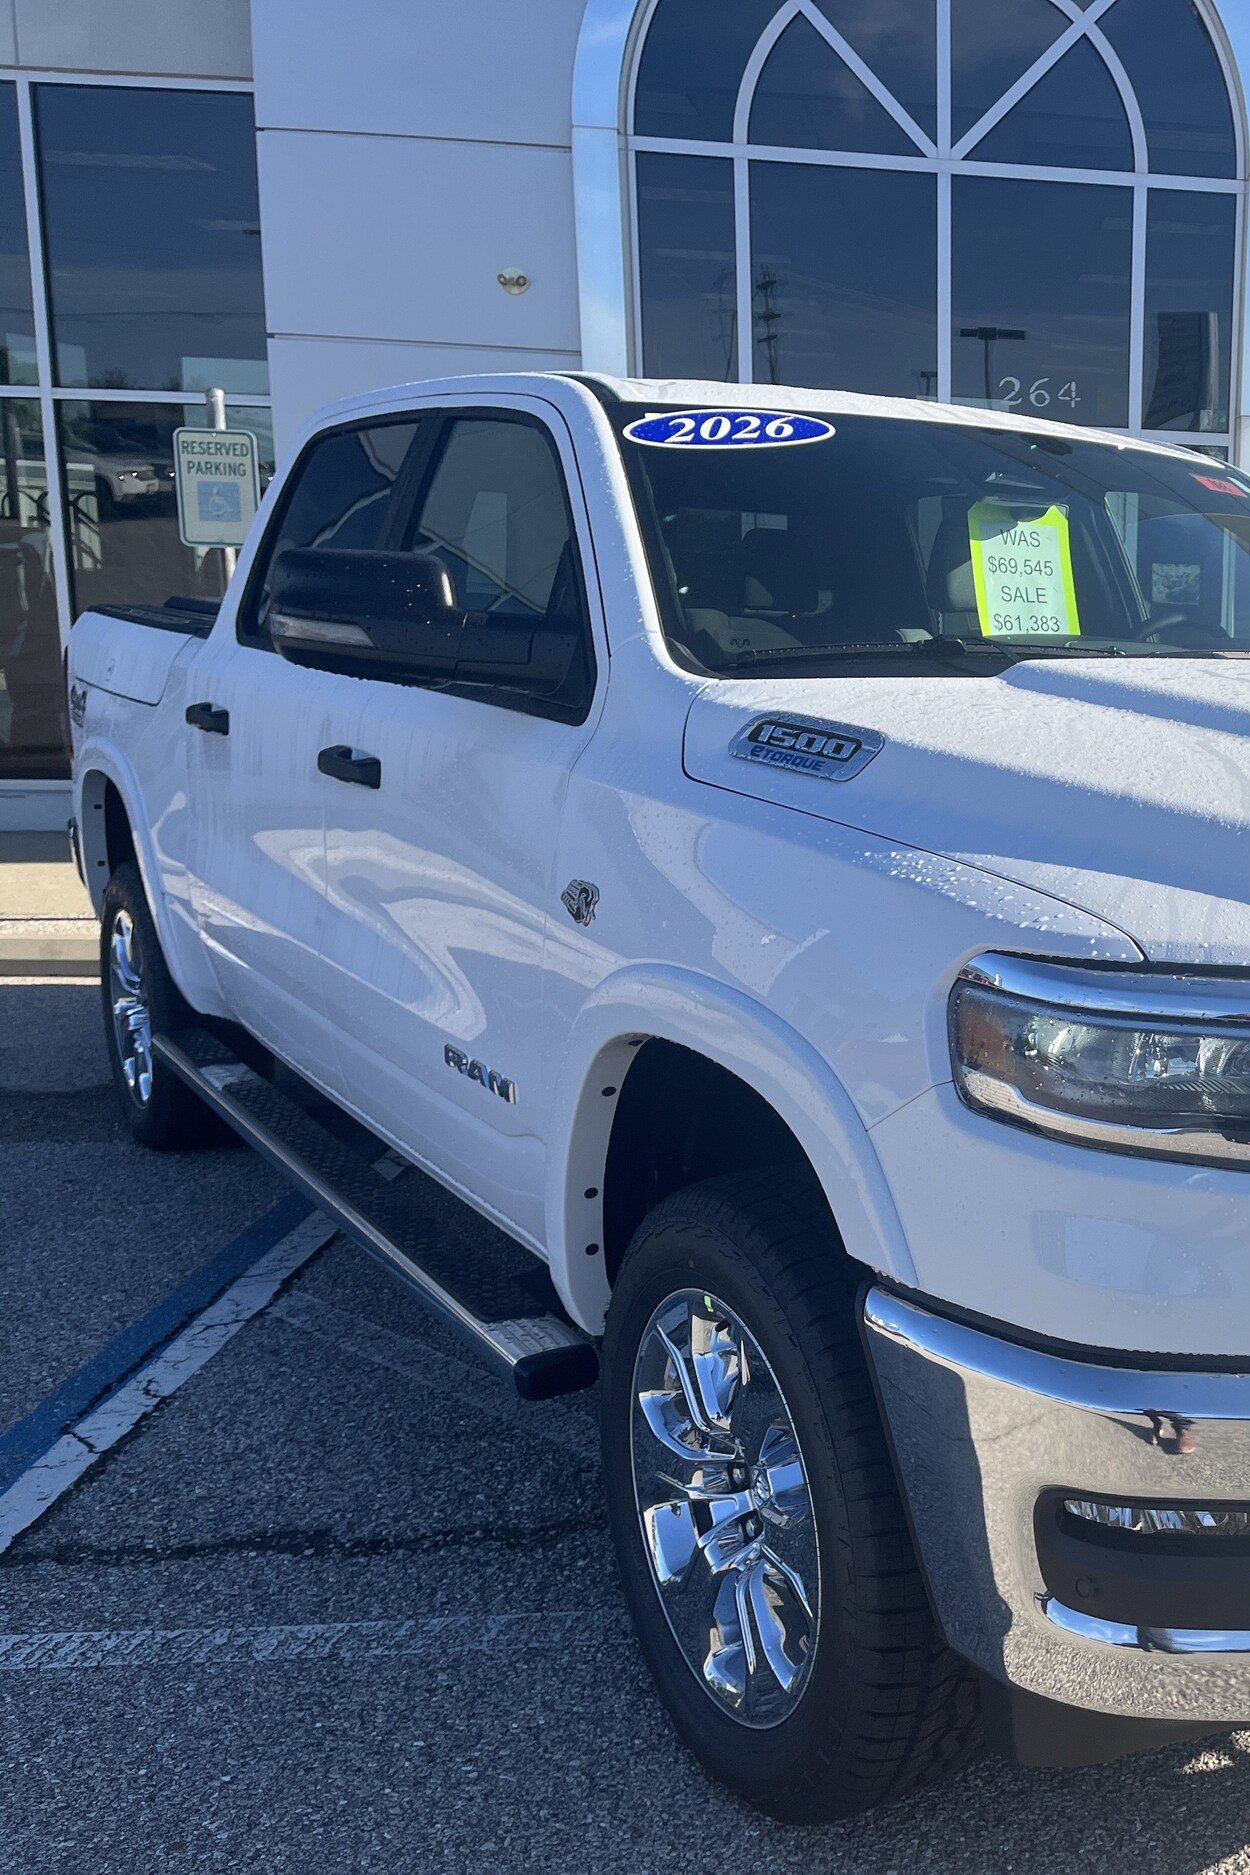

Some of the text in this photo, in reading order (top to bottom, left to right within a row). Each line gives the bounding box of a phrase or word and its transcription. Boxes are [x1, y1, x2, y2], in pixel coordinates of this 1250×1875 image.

[999, 376, 1081, 408] 264
[664, 416, 795, 443] 2026
[181, 440, 250, 457] RESERVED
[187, 461, 247, 477] PARKING
[1000, 528, 1041, 548] WAS
[987, 555, 1054, 578] $69,545
[1001, 585, 1048, 604] SALE
[993, 612, 1060, 634] $61,383
[757, 724, 858, 759] 1500
[444, 1043, 517, 1105] RAM
